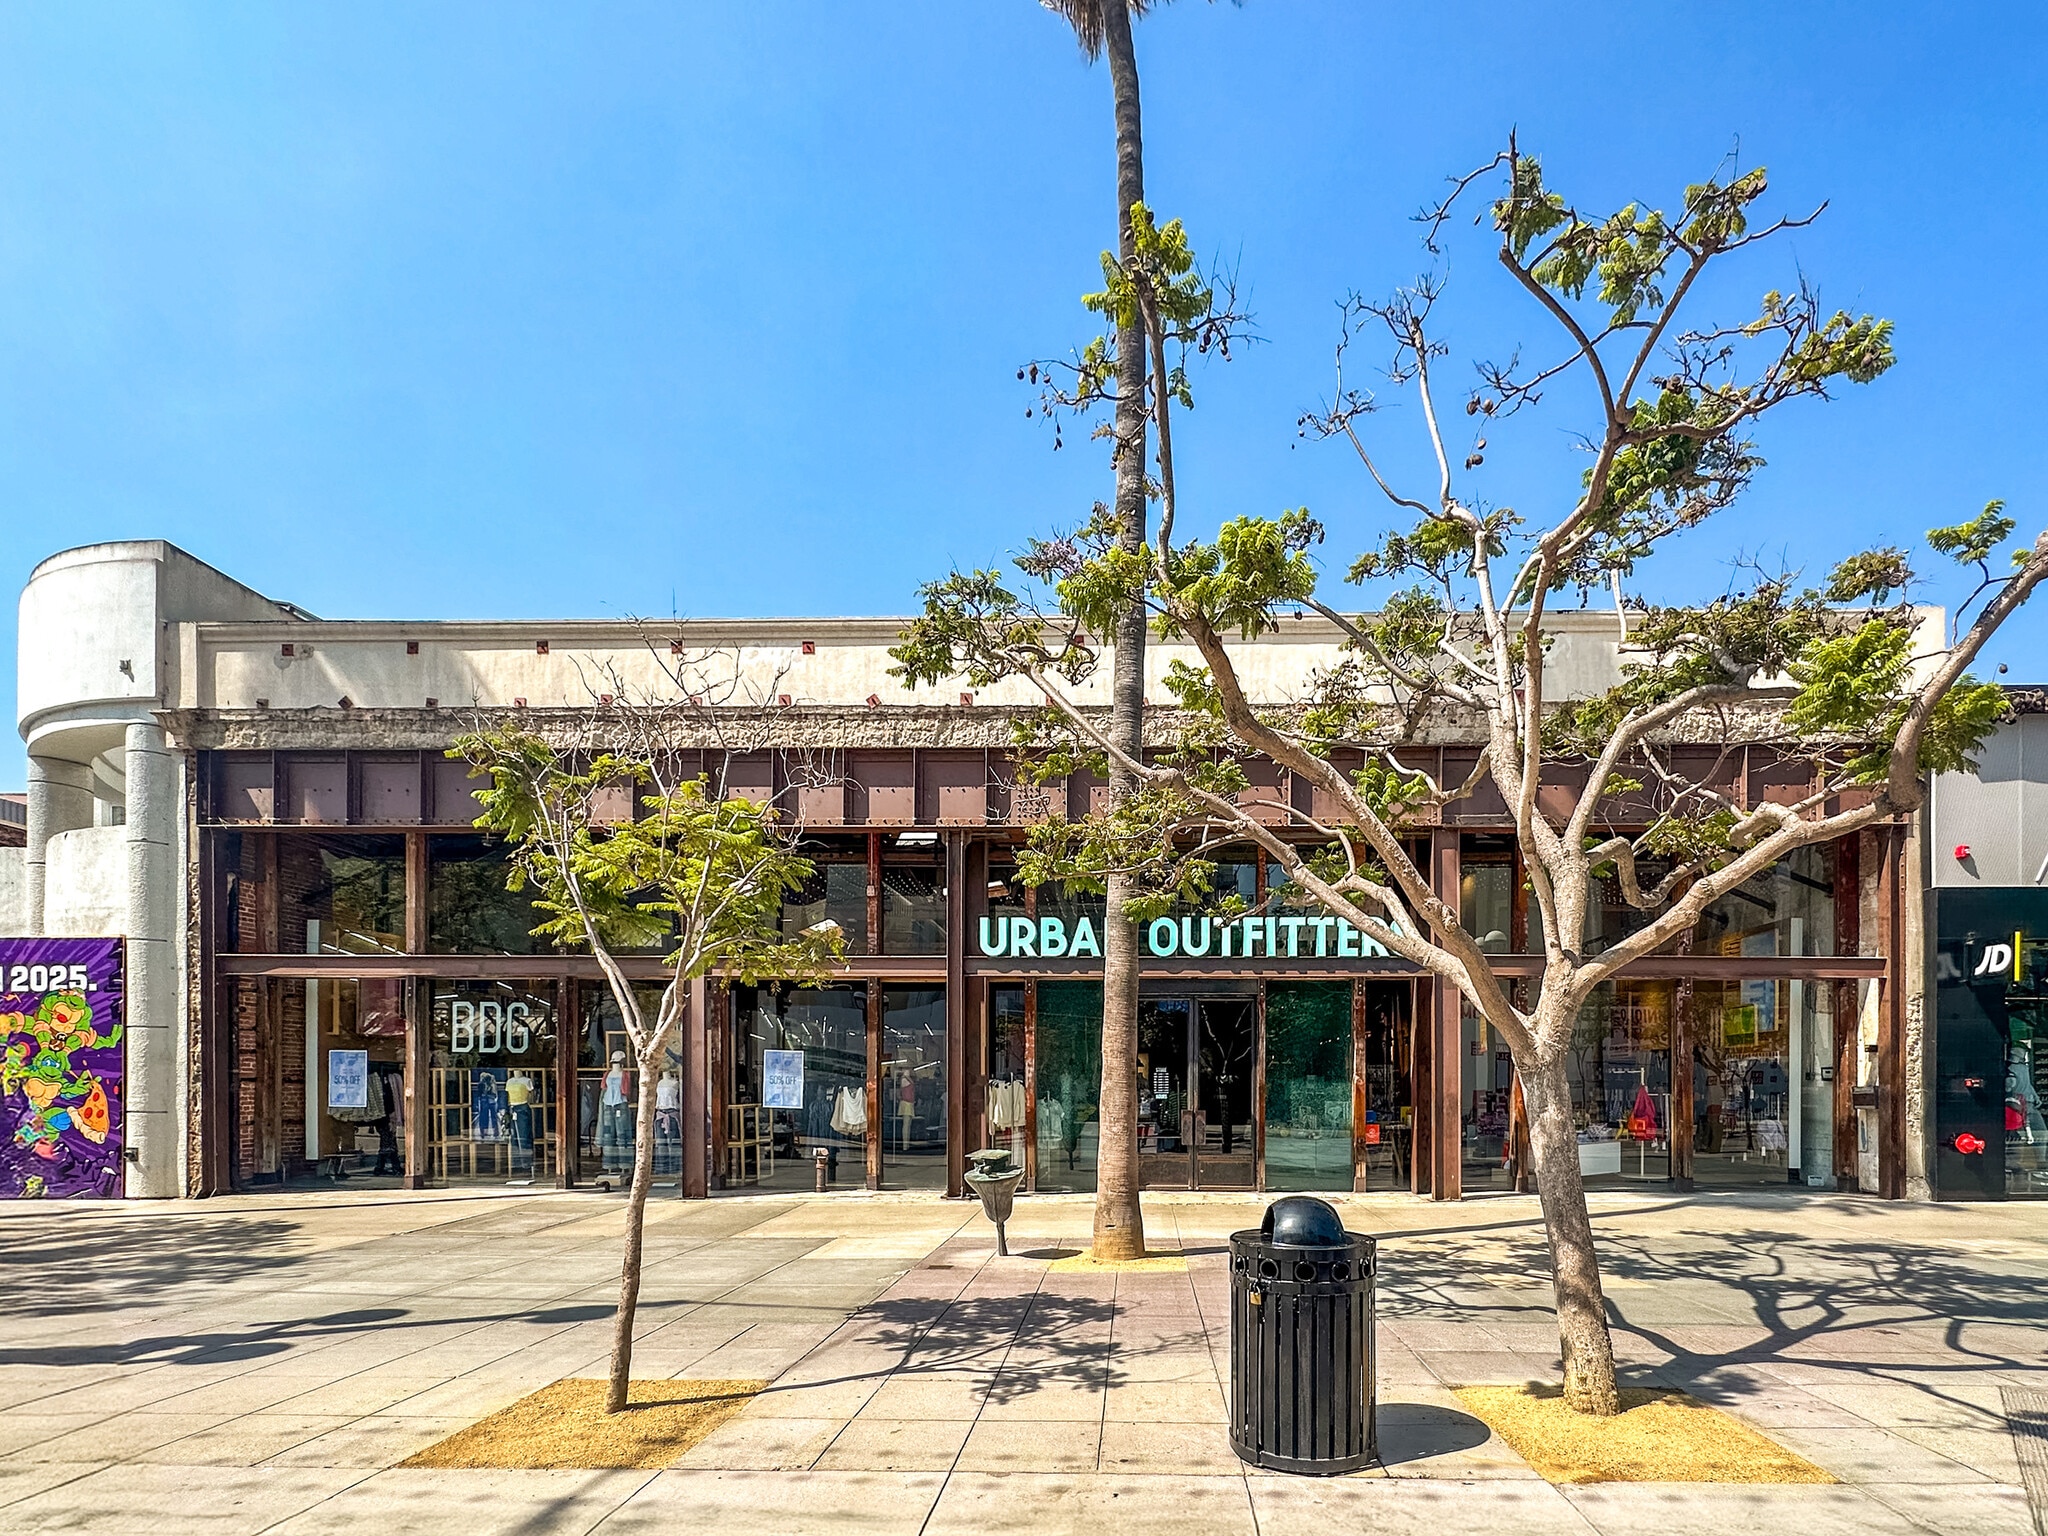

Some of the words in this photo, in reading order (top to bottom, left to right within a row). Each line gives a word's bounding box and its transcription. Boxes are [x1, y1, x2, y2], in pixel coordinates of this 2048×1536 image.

[979, 917, 1107, 957] URBA
[1149, 916, 1406, 957] OUTFITTER
[1974, 944, 2012, 976] JD
[10, 965, 98, 992] 2025.
[452, 1001, 529, 1054] BDG
[769, 1075, 785, 1085] 50%
[785, 1075, 797, 1085] OFF
